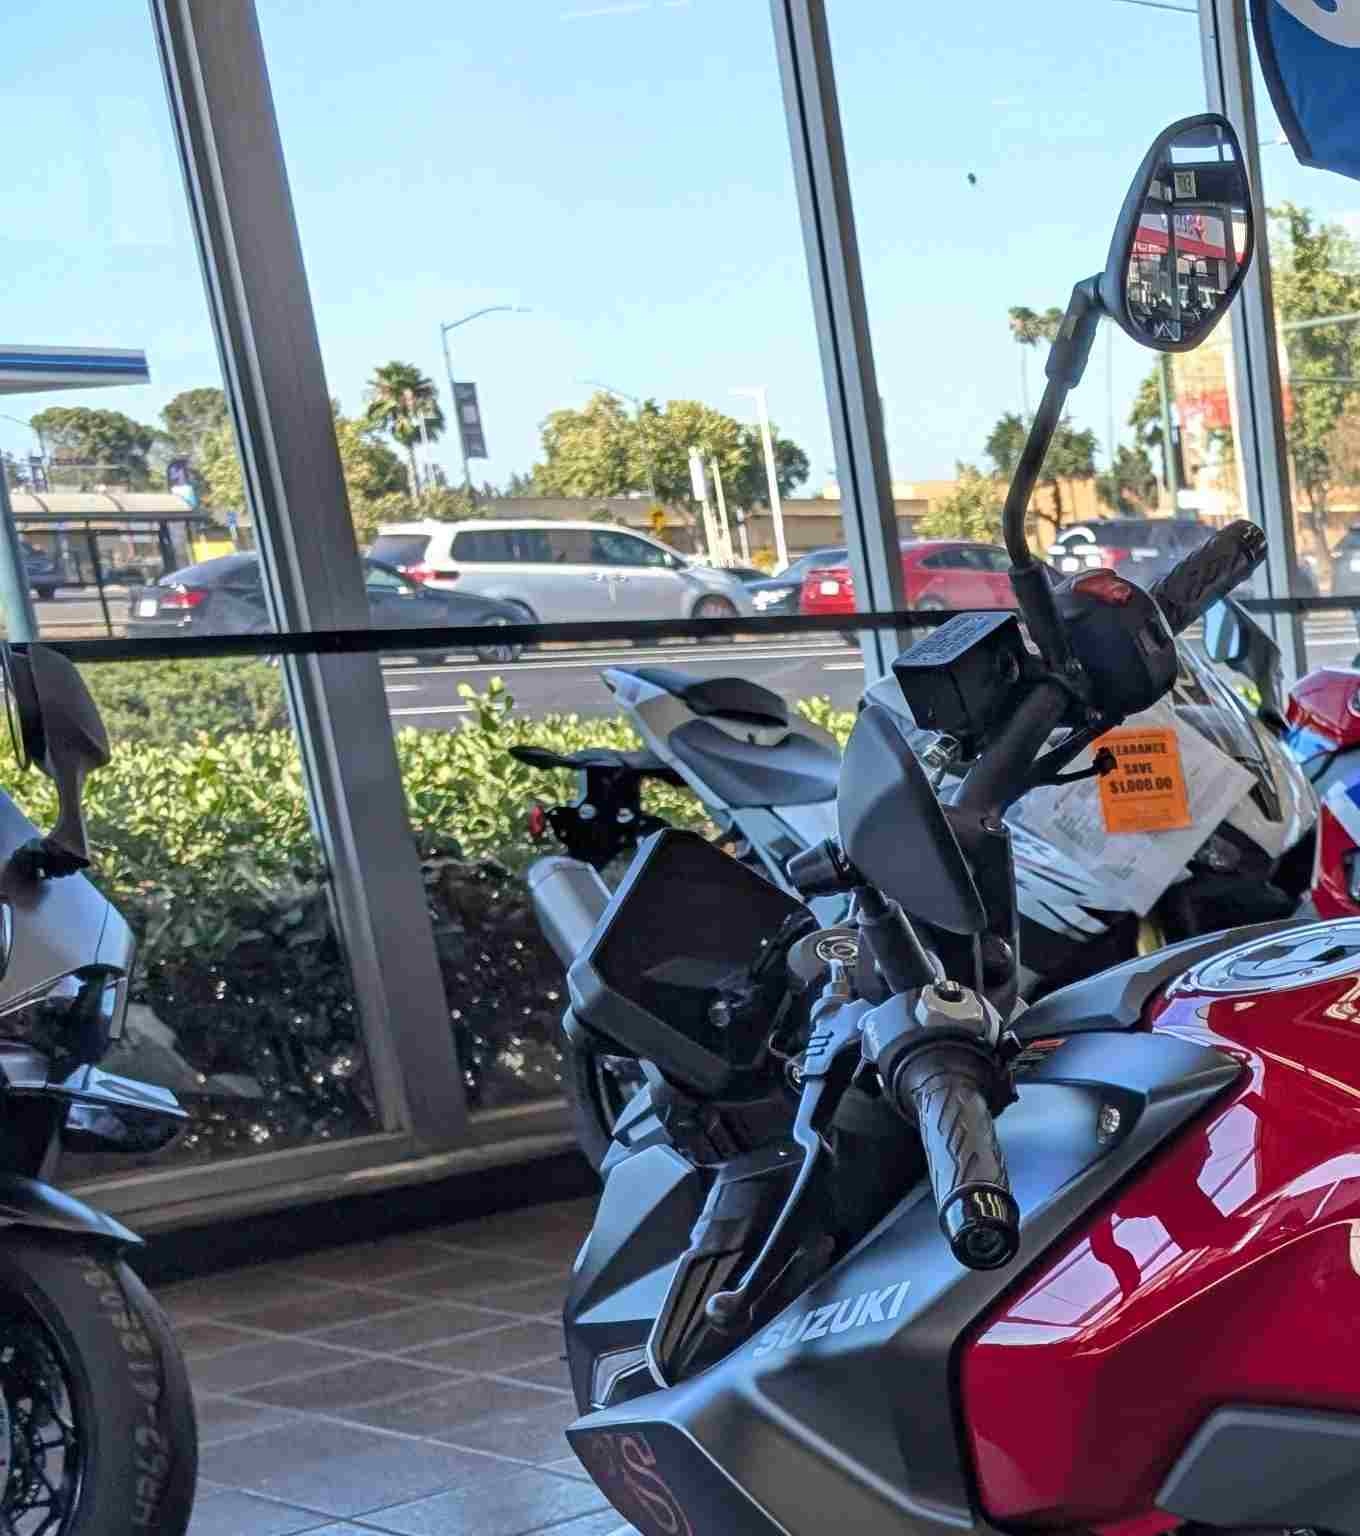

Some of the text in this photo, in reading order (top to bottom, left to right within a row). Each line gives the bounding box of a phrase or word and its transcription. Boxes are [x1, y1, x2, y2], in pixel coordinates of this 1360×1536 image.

[1108, 742, 1168, 756] LEARANCE
[1122, 762, 1153, 775] SAVE
[1109, 776, 1173, 795] $1,000.00
[752, 1279, 911, 1358] SUZUKI
